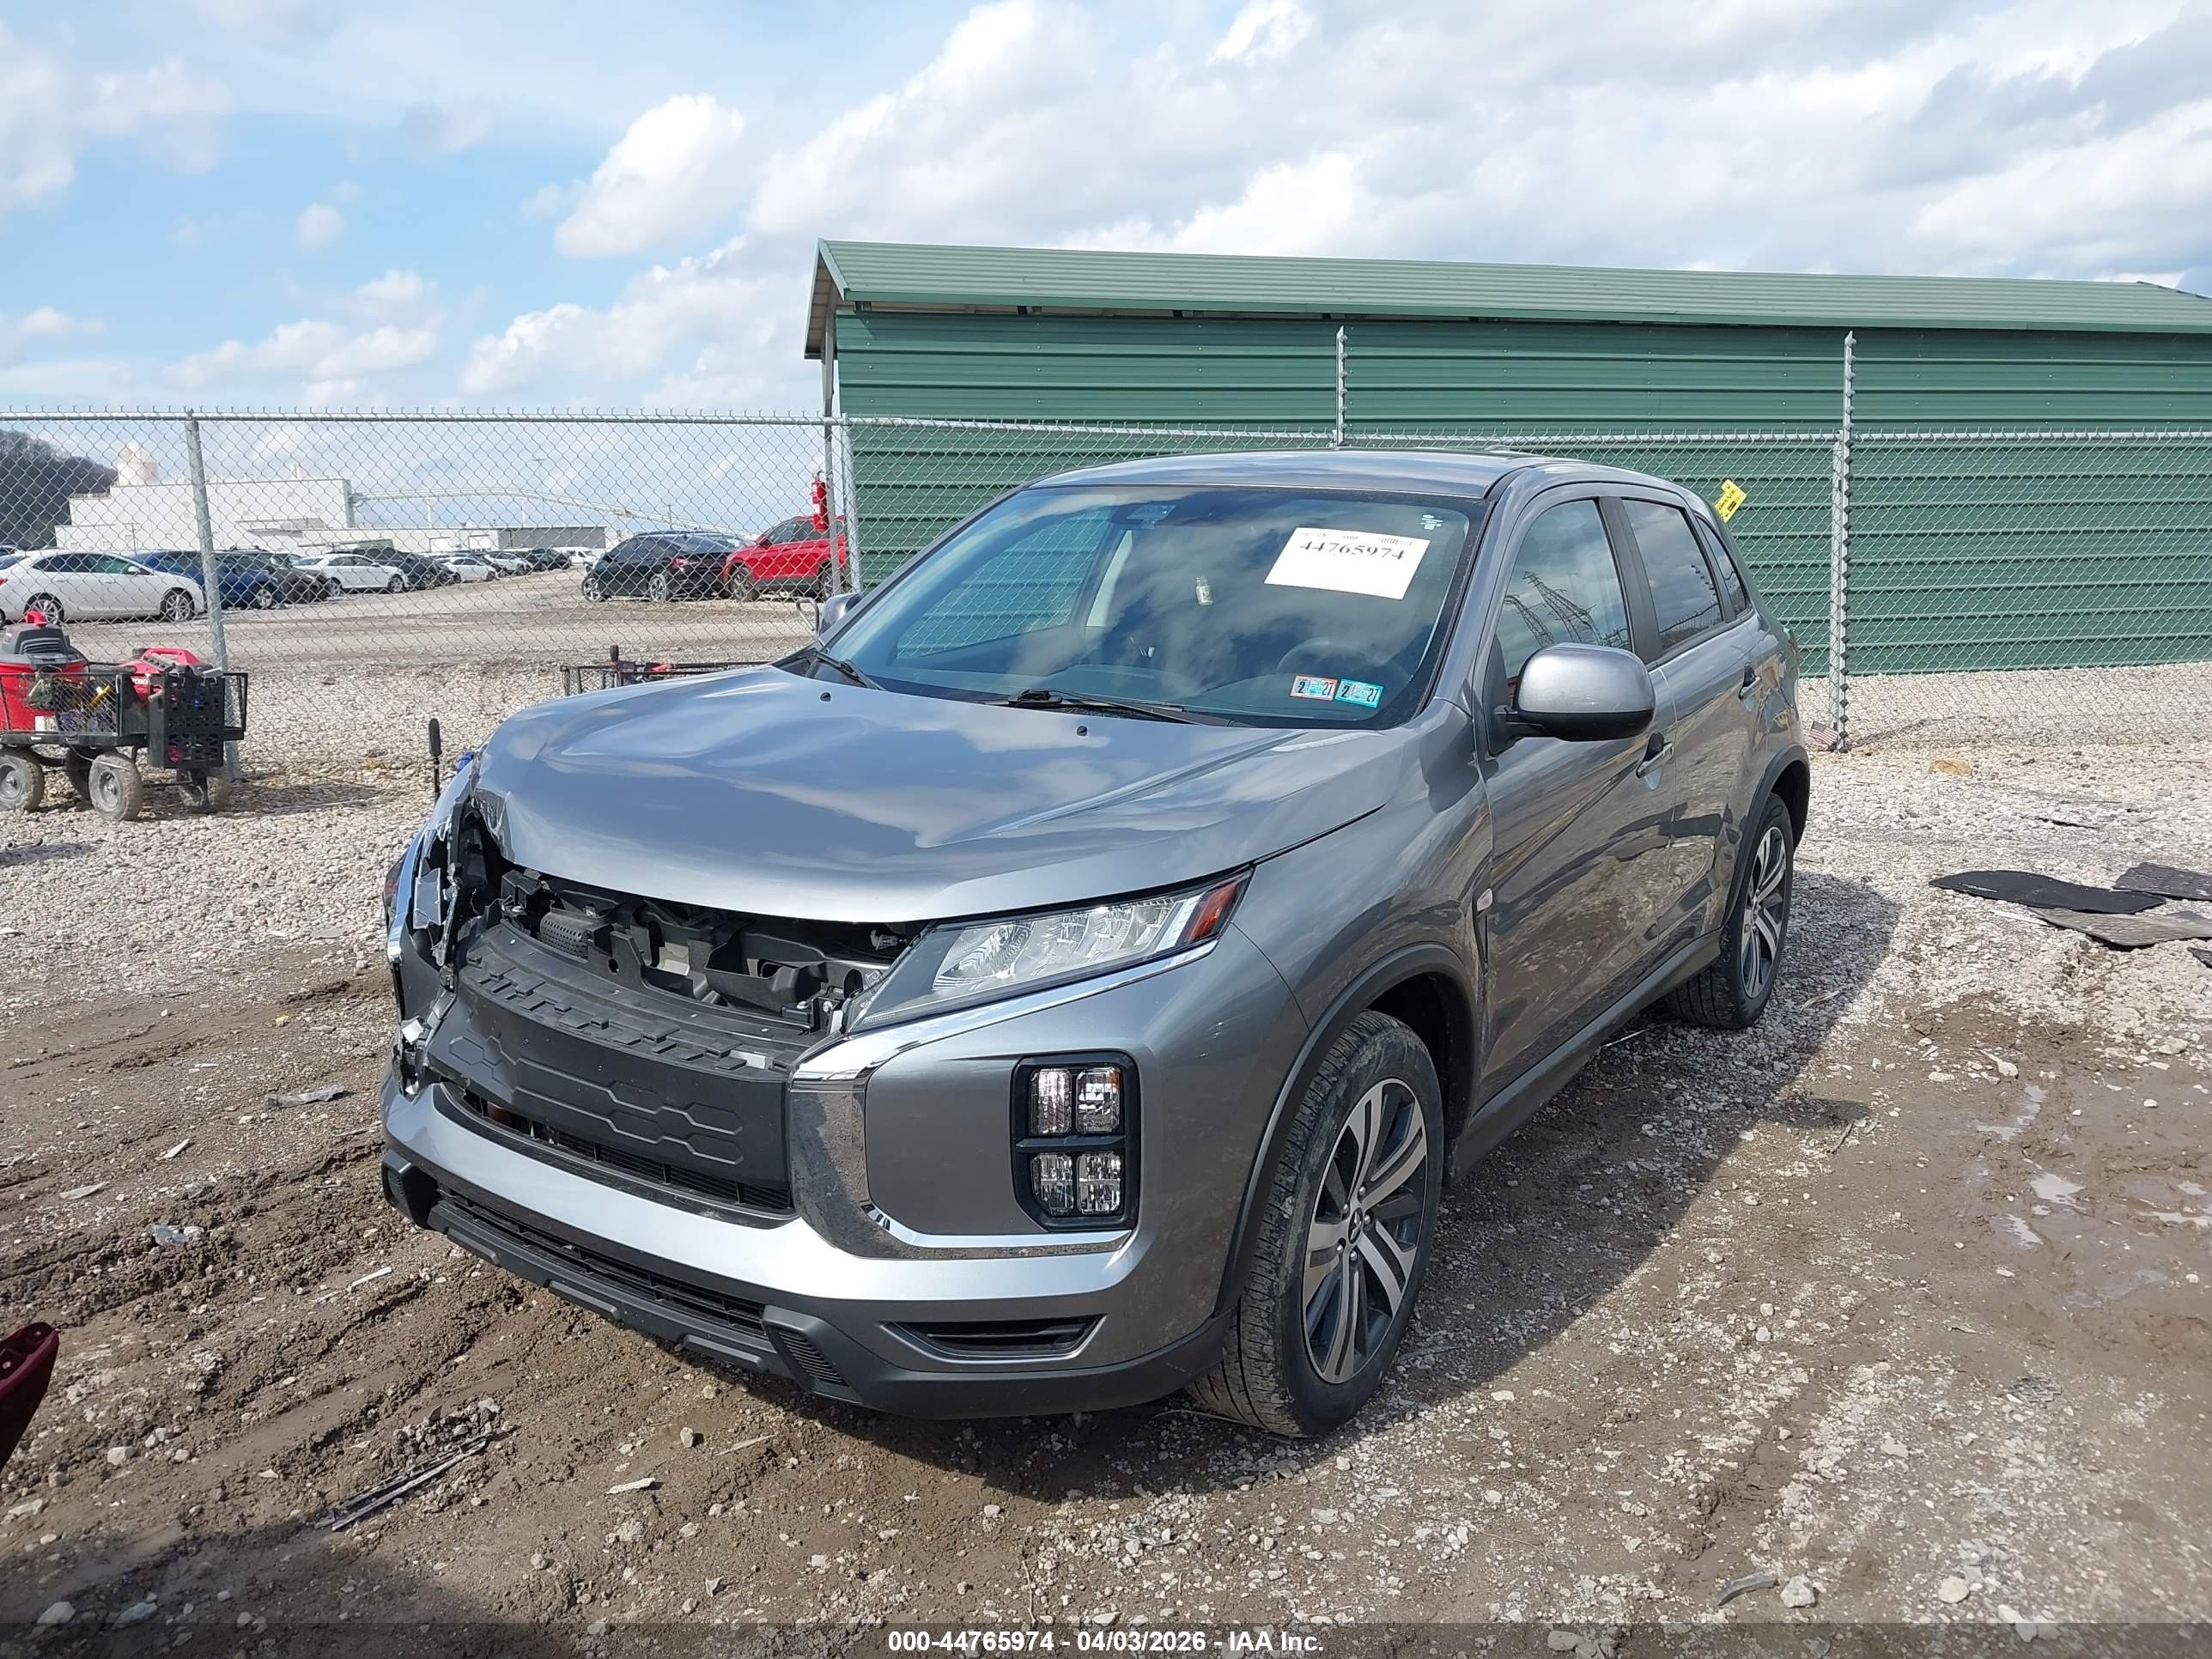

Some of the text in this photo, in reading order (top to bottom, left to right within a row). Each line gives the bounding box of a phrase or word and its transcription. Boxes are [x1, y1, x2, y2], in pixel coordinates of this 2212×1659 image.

[1299, 541, 1404, 559] 44765974
[1297, 681, 1305, 694] 2
[1322, 681, 1334, 696] 27
[1341, 684, 1350, 698] 2
[1366, 687, 1379, 703] 27
